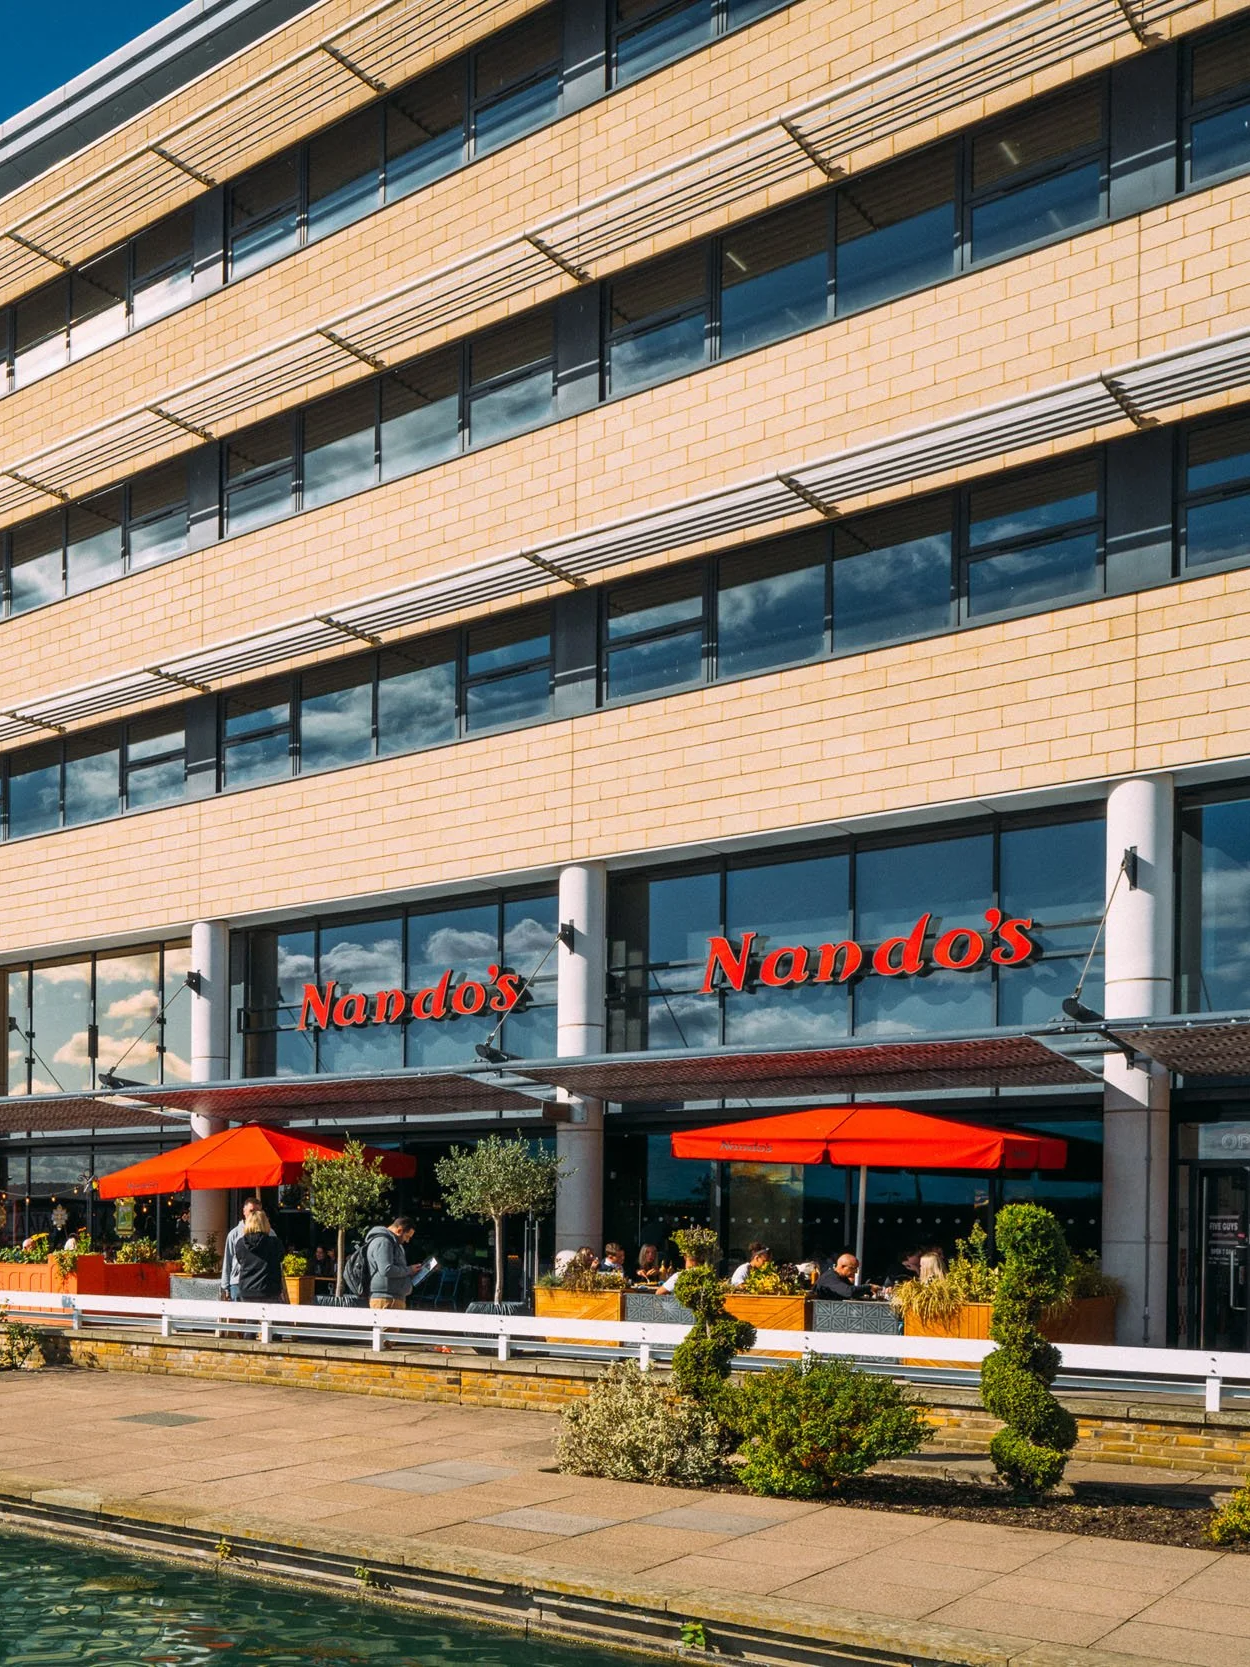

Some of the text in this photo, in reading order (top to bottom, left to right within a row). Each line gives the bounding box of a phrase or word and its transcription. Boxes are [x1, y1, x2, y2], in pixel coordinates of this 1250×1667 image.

[696, 908, 1033, 994] Nando's
[296, 964, 519, 1031] Nando's
[1222, 1222, 1238, 1231] GUYS
